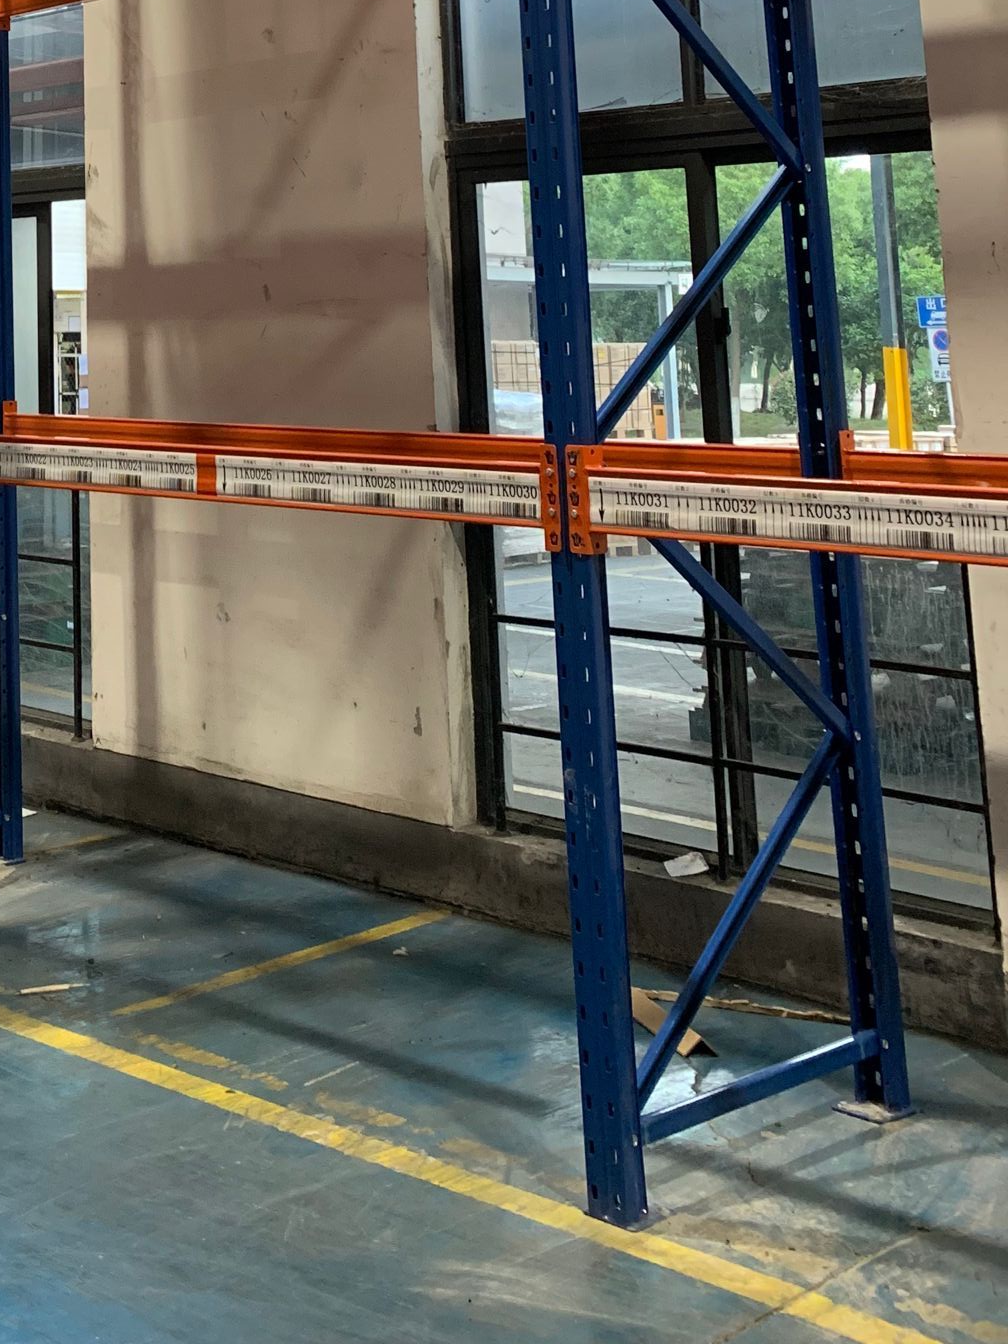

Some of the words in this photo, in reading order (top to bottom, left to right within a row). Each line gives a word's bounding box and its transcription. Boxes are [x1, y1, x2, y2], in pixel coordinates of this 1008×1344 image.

[17, 452, 47, 464] 11K0022
[62, 455, 93, 467] 11K0023
[109, 459, 142, 472] 11K0024
[160, 461, 195, 475] 11K0025
[234, 466, 272, 480] 11K0026
[291, 469, 332, 485] 11K0027
[353, 474, 397, 489] 11K0028
[418, 478, 464, 494] 11K0029
[489, 482, 538, 499] 11K0030
[615, 491, 670, 508] 11K0031
[698, 495, 757, 514] 11K0032
[788, 501, 852, 520] 11K0033
[886, 508, 954, 528] 11K0034
